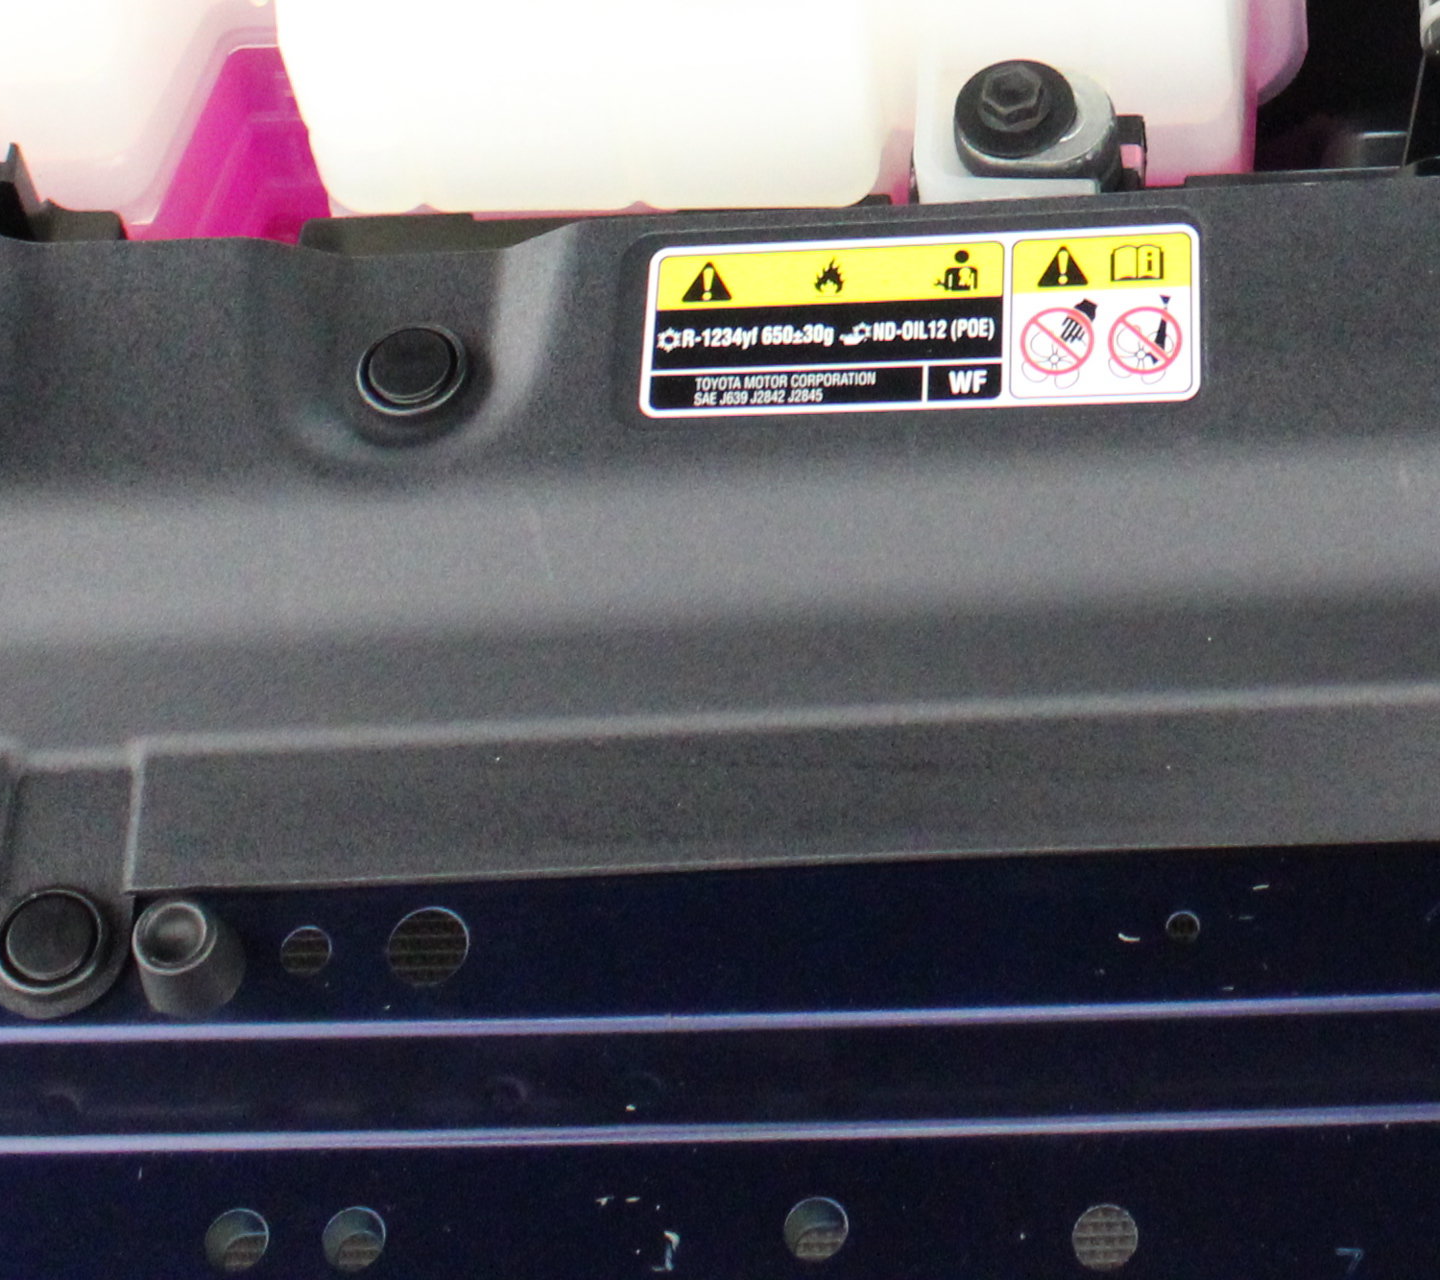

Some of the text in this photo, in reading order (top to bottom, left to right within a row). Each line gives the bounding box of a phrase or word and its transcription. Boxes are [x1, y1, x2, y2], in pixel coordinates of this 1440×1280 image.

[681, 317, 995, 350] R-1234yf 650±30g ND-OIL12 (POE)
[694, 369, 988, 394] TOYOTA MOTOR CORPORATION WF
[693, 388, 824, 407] SAE J639 J2842 J2845
